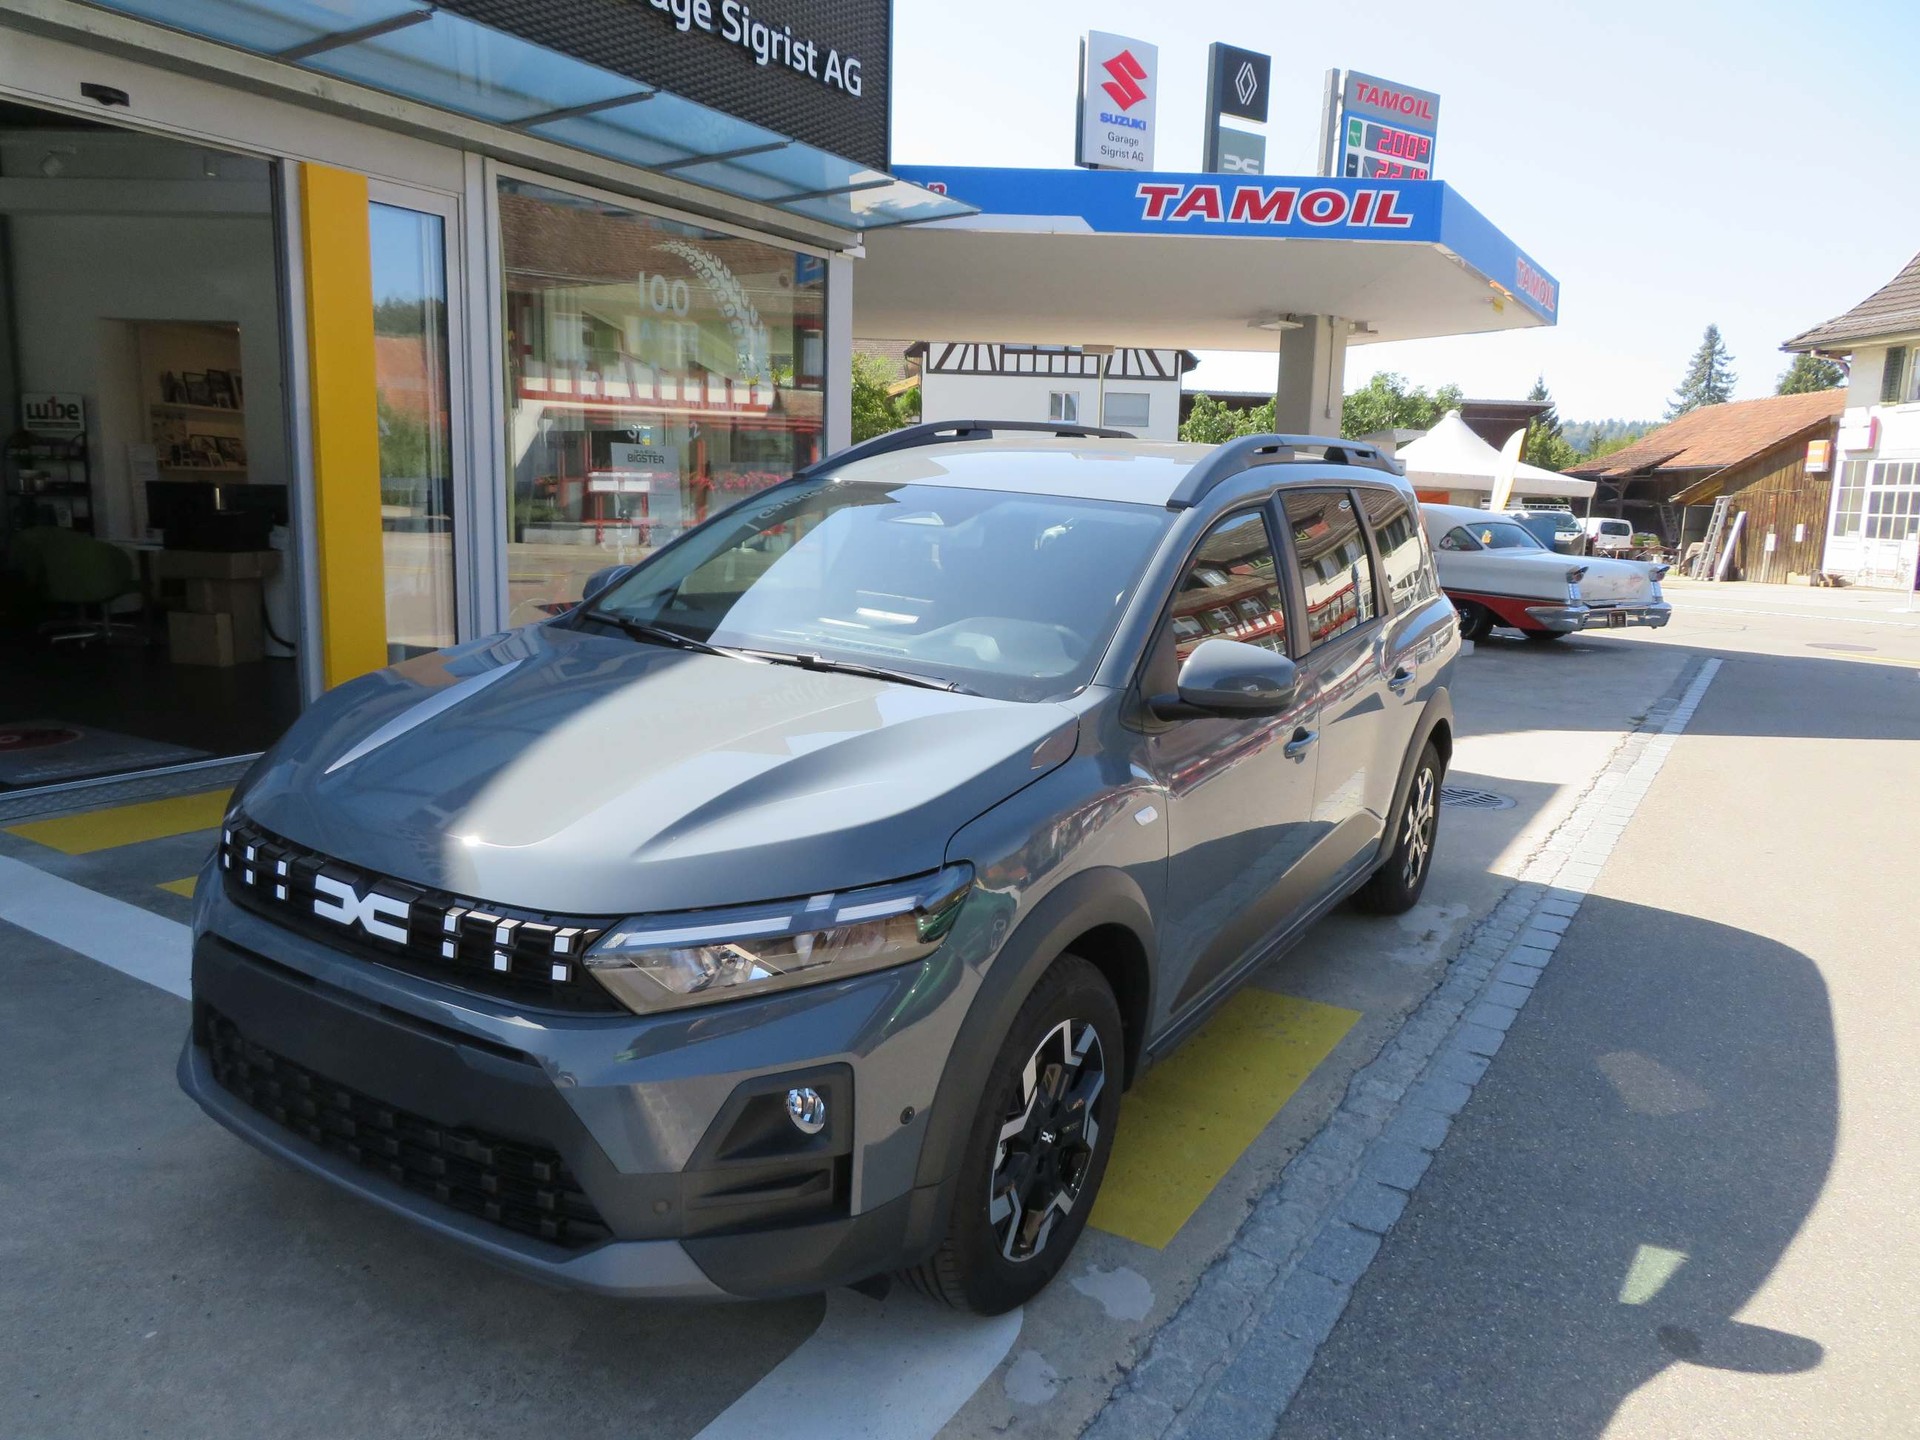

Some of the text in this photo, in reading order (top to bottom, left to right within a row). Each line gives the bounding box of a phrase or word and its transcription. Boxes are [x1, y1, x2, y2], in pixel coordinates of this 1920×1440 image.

[722, 0, 817, 79] Sigrist
[824, 50, 862, 96] AG
[1356, 83, 1433, 121] TAMOIL
[1100, 112, 1147, 131] SUZUKI
[1107, 131, 1139, 147] Garage
[1100, 145, 1144, 162] Sigrist AG
[1135, 183, 1415, 228] TAMOIL
[1516, 257, 1555, 313] TAMOIL
[627, 453, 665, 464] BIGSTER
